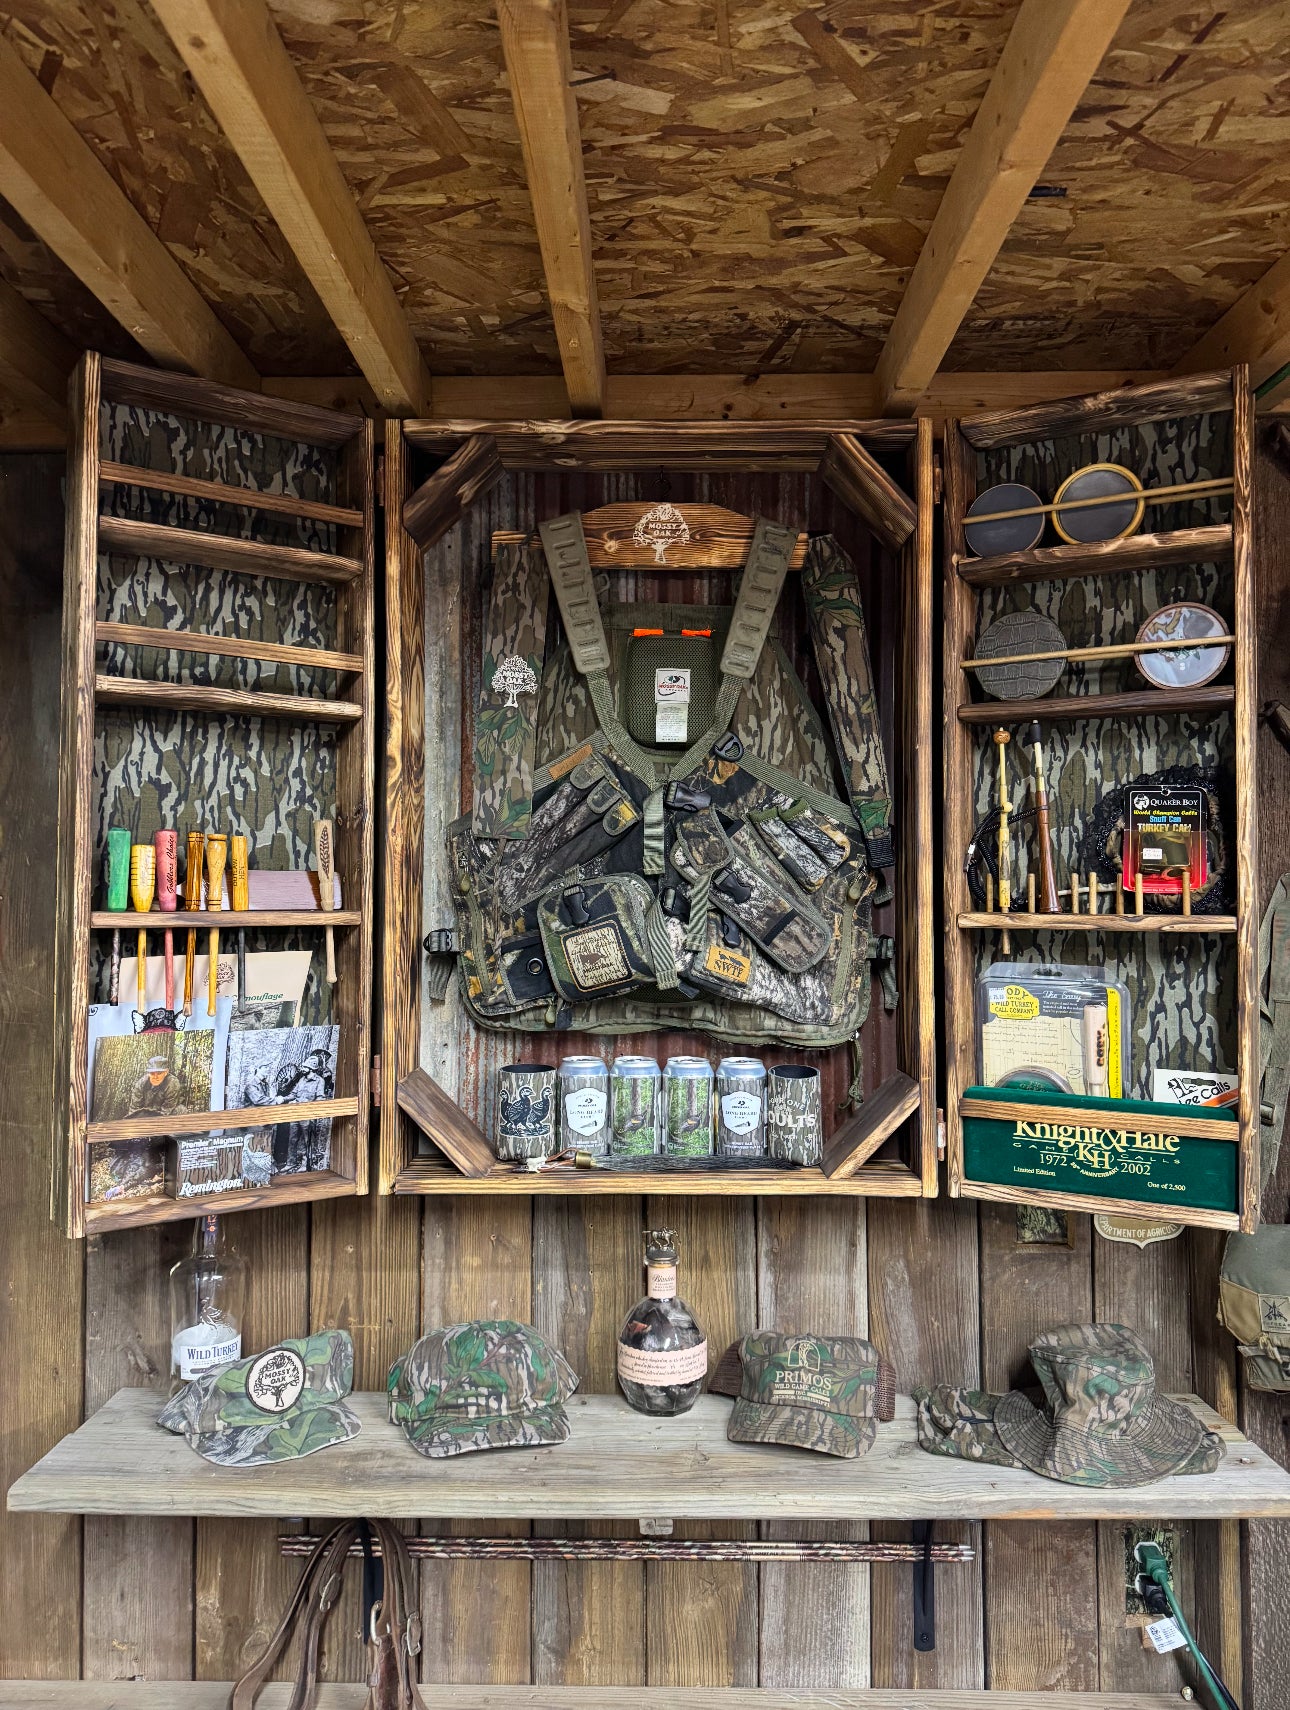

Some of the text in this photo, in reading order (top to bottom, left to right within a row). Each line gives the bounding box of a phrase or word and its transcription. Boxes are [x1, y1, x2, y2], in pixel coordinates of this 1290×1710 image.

[1150, 798, 1199, 806] QUAKER BOY
[1149, 815, 1182, 823] Snuff Can
[1137, 823, 1170, 833] TURKEY
[1006, 987, 1028, 999] ODY
[1010, 1001, 1034, 1009] TURKEY
[1200, 1081, 1231, 1100] Calls
[787, 1099, 805, 1111] ONE
[768, 1110, 816, 1128] OULTS
[213, 1136, 243, 1146] Magnum
[1040, 1153, 1151, 1175] 1972 2002
[1013, 1165, 1056, 1177] Limited Edition
[1099, 1214, 1136, 1238] EPARTMENT
[1136, 1229, 1147, 1238] OF
[188, 1348, 211, 1360] WILD
[211, 1341, 239, 1358] TURKEY
[265, 1368, 290, 1380] MOSSY
[774, 1370, 832, 1390] PRIMOS
[270, 1376, 286, 1385] OAK
[791, 1383, 810, 1391] GAME
[810, 1385, 830, 1397] CALLS
